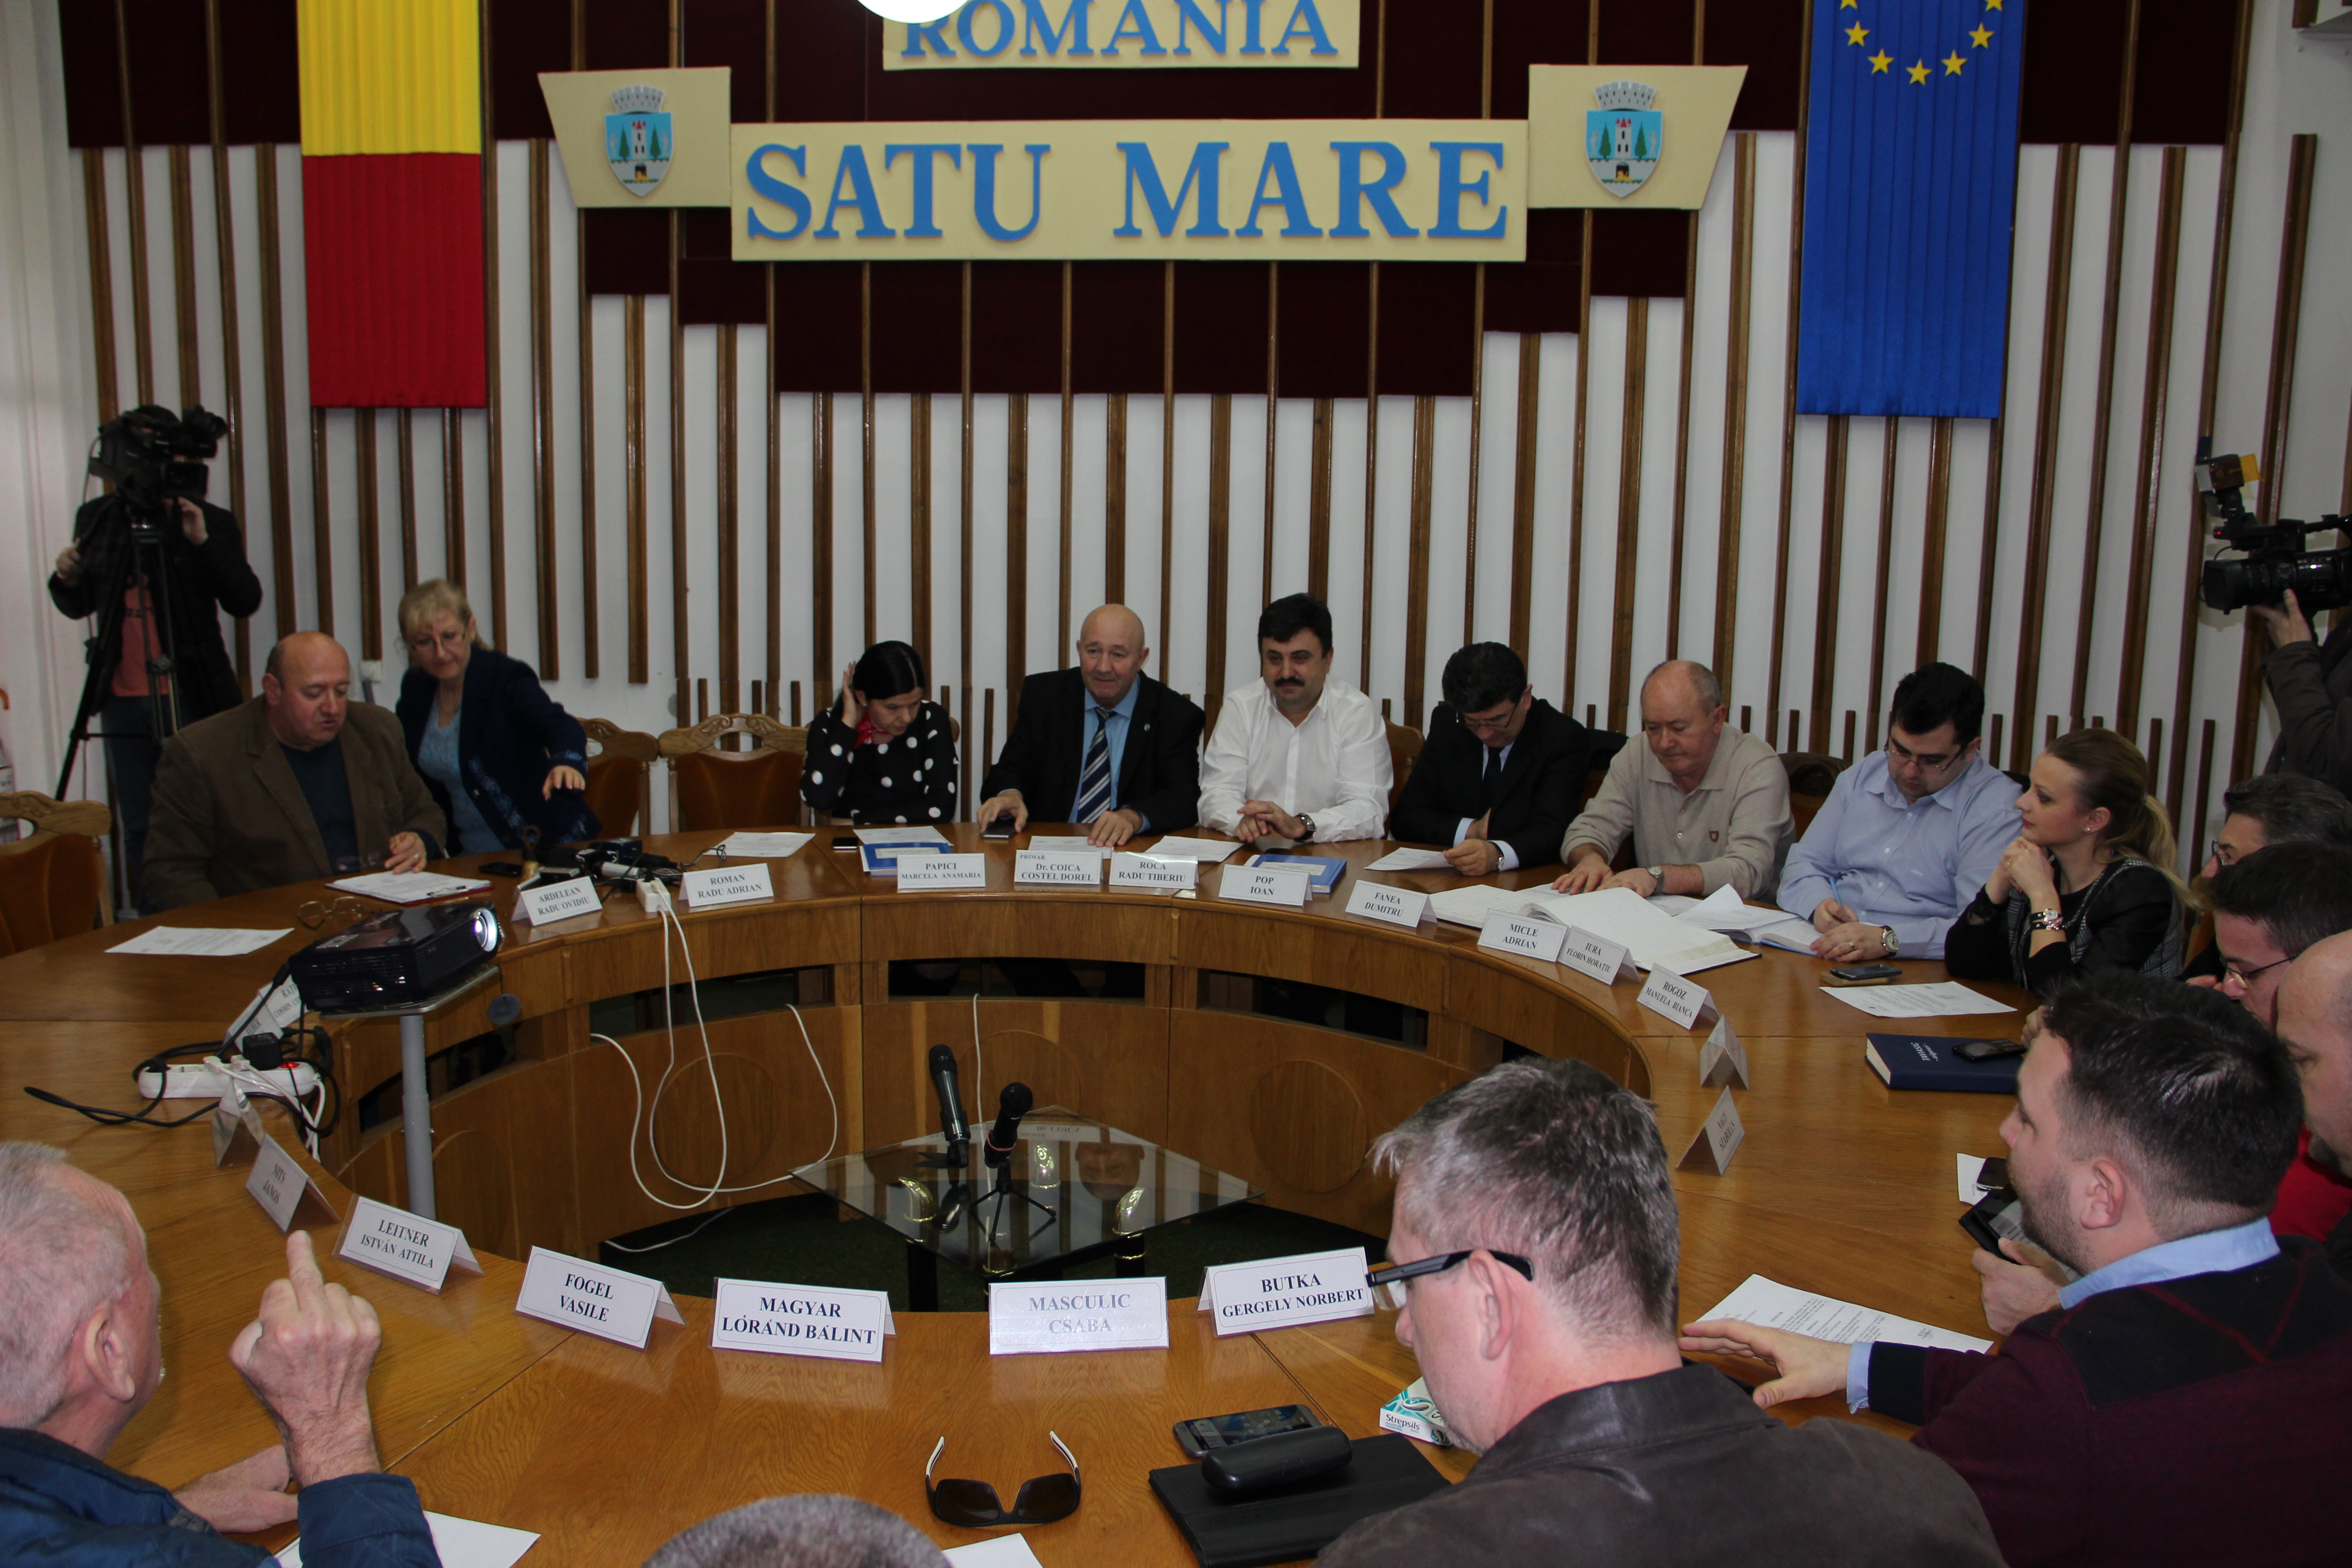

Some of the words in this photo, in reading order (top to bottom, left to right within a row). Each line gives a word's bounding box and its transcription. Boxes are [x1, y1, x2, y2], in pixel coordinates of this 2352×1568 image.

[745, 143, 1050, 241] SATU
[1114, 142, 1506, 239] MARE
[1140, 862, 1166, 870] ROCA
[710, 874, 745, 885] ROMAN
[1147, 873, 1186, 882] TIBERIU
[1255, 876, 1274, 884] POP
[540, 887, 581, 902] ARDELEAN
[698, 888, 724, 898] RADU
[727, 883, 762, 895] ADRIAN
[1250, 887, 1274, 895] IOAN
[1375, 892, 1401, 904] FANEA
[538, 903, 560, 915] RADU
[562, 897, 590, 909] OVIDIU
[1365, 902, 1404, 916] DUMITRU
[1509, 924, 1539, 937] MICLE
[1502, 936, 1537, 949] ADRIAN
[1585, 943, 1601, 956] IURA
[1567, 948, 1587, 961] FLORIN
[1663, 981, 1687, 1000] ROGOZ
[1645, 987, 1671, 1006] MANUELA
[1671, 1002, 1692, 1018] BIANCA
[378, 1220, 429, 1247] LEITNER
[361, 1234, 397, 1254] ISTVÁN
[398, 1248, 434, 1268] ATTILA
[564, 1273, 613, 1299] FOGEL
[1260, 1273, 1321, 1293] BUTKA
[560, 1294, 609, 1322] VASILE
[759, 1297, 842, 1318] MAGYAR
[1029, 1294, 1130, 1311] MASCULIC
[1223, 1298, 1292, 1317] GERGELY
[1295, 1288, 1363, 1308] NORBERT
[722, 1314, 800, 1337] LÓRÁND
[805, 1324, 876, 1344] BÁLINT
[1049, 1318, 1112, 1334] CSABA
[1386, 1413, 1420, 1431] Strepsils
